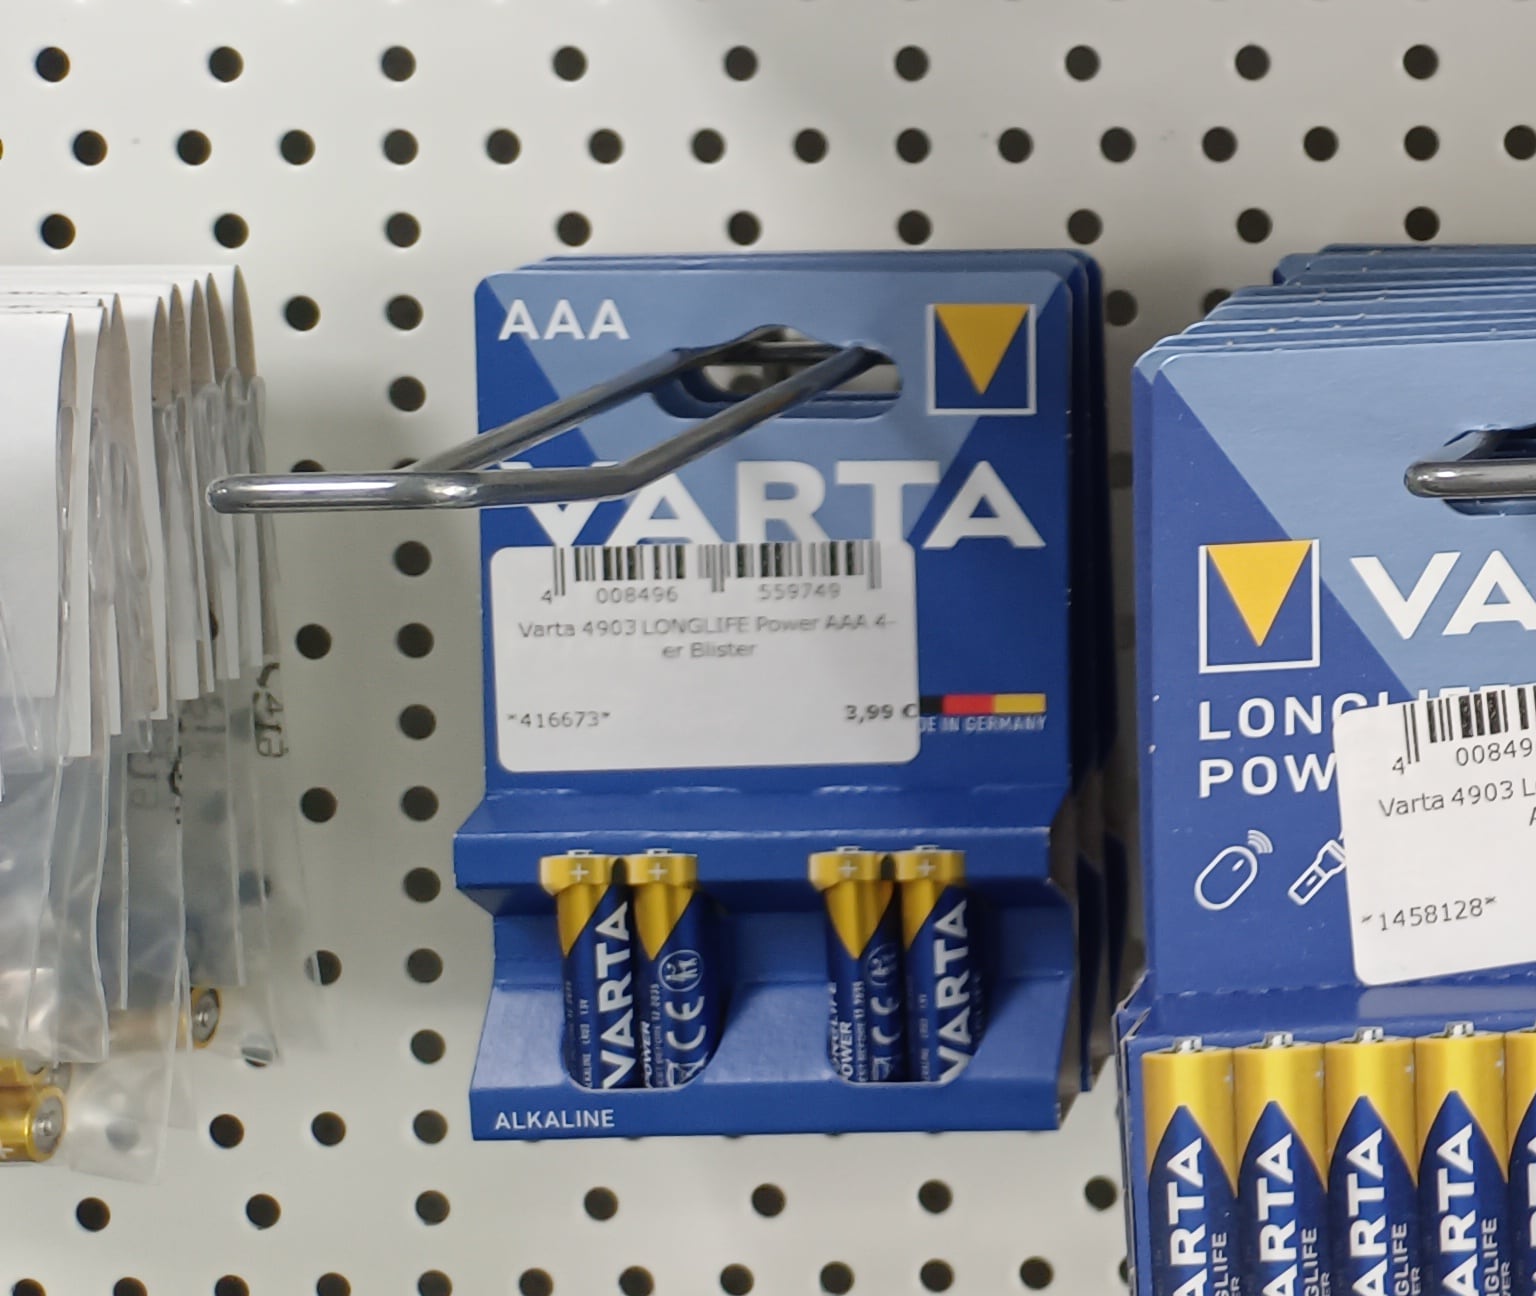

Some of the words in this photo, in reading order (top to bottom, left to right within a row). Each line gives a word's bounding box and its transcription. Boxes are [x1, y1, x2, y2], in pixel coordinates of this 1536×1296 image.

[498, 299, 630, 340] AAA
[596, 586, 678, 604] 008496
[519, 620, 575, 639] Varta
[582, 618, 637, 637] 4903
[642, 617, 750, 636] LONGLIFE
[757, 615, 819, 633] Power
[825, 613, 868, 632] AAA
[689, 640, 757, 659] Blister
[845, 704, 895, 724] 3,99
[1379, 790, 1445, 817] Varta
[1451, 780, 1513, 806] 4903
[495, 1109, 615, 1130] ALKALINE
